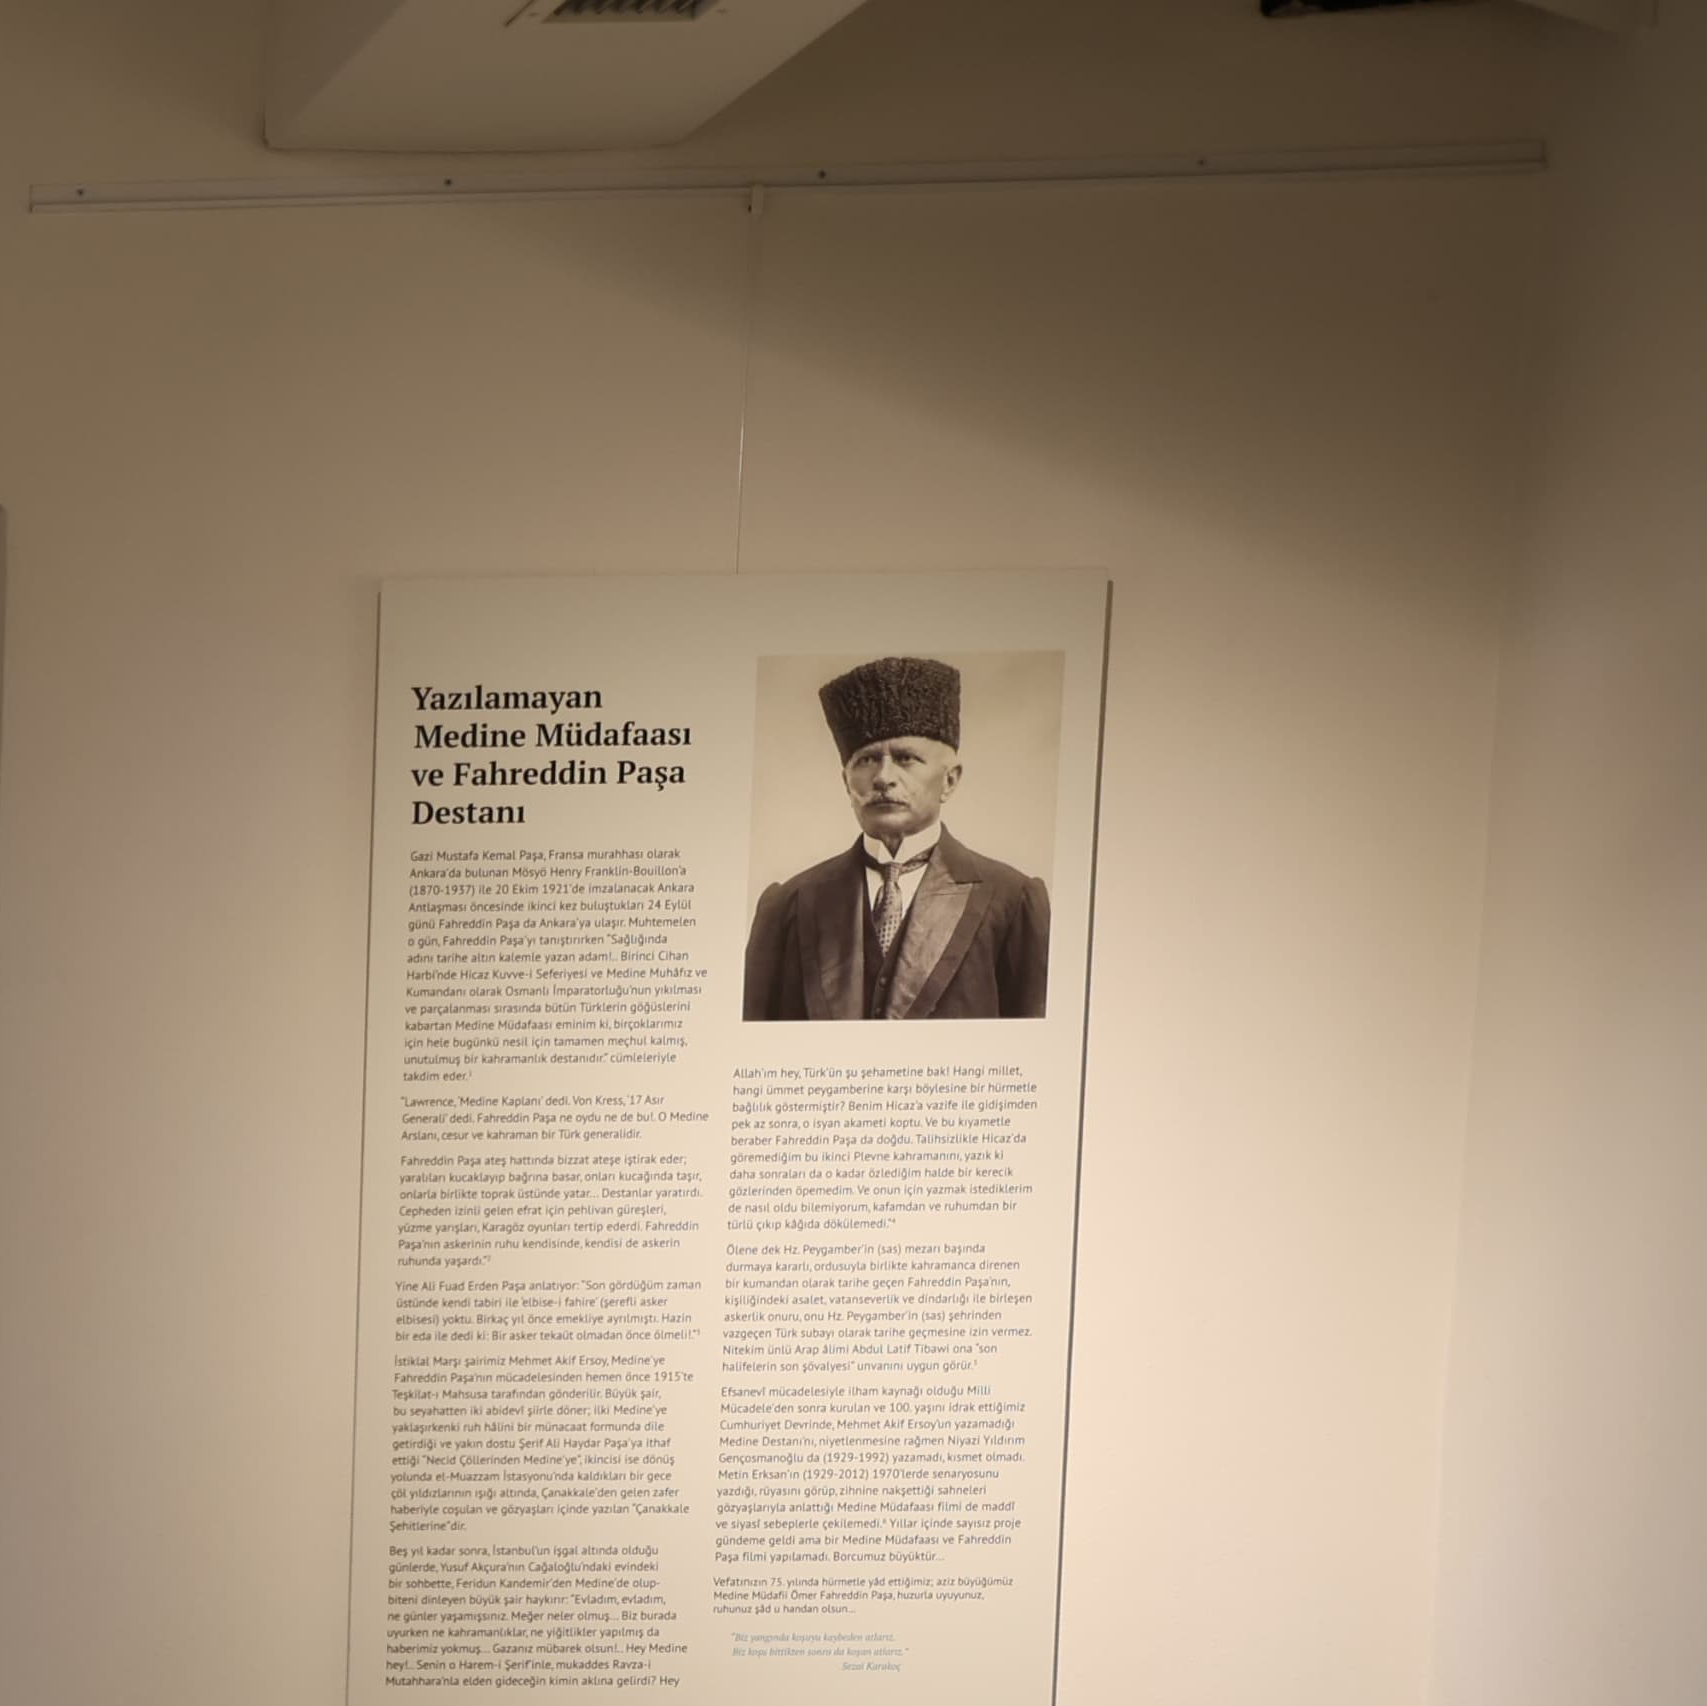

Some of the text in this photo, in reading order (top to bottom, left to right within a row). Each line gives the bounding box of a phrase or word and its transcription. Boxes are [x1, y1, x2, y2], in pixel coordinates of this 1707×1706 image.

[411, 683, 602, 716] Yazılamayan
[414, 720, 691, 748] Medine Müdafaası
[411, 759, 685, 792] ve Fahreddin Paşa
[412, 800, 525, 824] Destanı
[410, 850, 433, 862] Gazi
[436, 850, 479, 861] Mustafa
[482, 849, 516, 861] Kemal
[548, 848, 584, 860] Fransa
[587, 848, 643, 859] murahhası
[646, 848, 680, 859] olarak
[465, 867, 509, 878] bulunan
[511, 866, 547, 880] Mösyö
[549, 866, 582, 879] Henry
[408, 884, 475, 898] (1870-1937)
[478, 884, 492, 895] ile
[495, 883, 509, 895] 20
[512, 883, 538, 894] Ekim
[588, 882, 654, 893] imzalanacak
[657, 881, 694, 893] Ankara
[408, 898, 691, 914] Antlaşması öncesinde ikinci kez buluştukları 24 Eylül
[408, 919, 435, 932] günü
[438, 918, 492, 929] Fahreddin
[495, 917, 520, 931] Paşa
[522, 917, 536, 928] da
[628, 916, 696, 927] Muhtemelen
[407, 938, 414, 946] o
[442, 935, 496, 946] Fahreddin
[539, 934, 604, 947] tanıştırırken
[845, 1069, 857, 1080] şu
[860, 1066, 923, 1080] şehametine
[952, 1064, 984, 1079] Hangi
[732, 1081, 1037, 1098] hangi ümmet peygamberine karşı böylesine bir hürmetle
[732, 1101, 772, 1115] bağlılık
[848, 1100, 882, 1111] Benim
[925, 1099, 958, 1110] vazife
[961, 1099, 975, 1110] ile
[977, 1098, 1037, 1112] gidişimden
[400, 1155, 454, 1166] Fahreddin
[457, 1154, 481, 1168] Paşa
[484, 1156, 506, 1168] ateş
[509, 1154, 554, 1165] hattında
[557, 1155, 589, 1165] bizzat
[592, 1155, 621, 1167] ateşe
[623, 1153, 657, 1167] iştirak
[399, 1172, 445, 1184] yaralıları
[449, 1171, 505, 1184] kucaklayıp
[508, 1171, 549, 1184] bağrına
[584, 1171, 615, 1181] onları
[618, 1170, 673, 1184] kucağında
[394, 1372, 447, 1383] Fahreddin
[495, 1372, 582, 1383] mücadelesinden
[585, 1371, 622, 1382] hemen
[624, 1371, 651, 1382] önce
[718, 1452, 803, 1466] Gençosmanoğlu
[806, 1452, 819, 1463] da
[822, 1451, 889, 1464] (1929-1992)
[947, 1452, 982, 1462] kısmet
[390, 1471, 432, 1484] yolunda
[435, 1471, 500, 1482] el-Muazzam
[577, 1470, 626, 1481] kaldıkları
[629, 1471, 644, 1480] bir
[646, 1472, 672, 1483] gece
[718, 1469, 748, 1480] Metin
[802, 1468, 869, 1481] (1929-2012)
[932, 1470, 999, 1481] senaryosunu
[712, 1576, 767, 1587] Vefatınızın
[786, 1577, 819, 1588] yılında
[821, 1576, 866, 1586] hürmetle
[868, 1576, 885, 1588] yâd
[936, 1577, 955, 1586] aziz
[957, 1576, 1013, 1588] büyüğümüz
[713, 1591, 749, 1600] Medine
[751, 1590, 788, 1600] Müdafii
[790, 1589, 817, 1600] Ömer
[819, 1590, 868, 1600] Fahreddin
[897, 1590, 933, 1600] huzurla
[462, 1676, 492, 1686] elden
[494, 1675, 546, 1688] gideceğin
[549, 1676, 578, 1685] kimin
[581, 1675, 613, 1686] aklına
[659, 1675, 680, 1688] Hey
